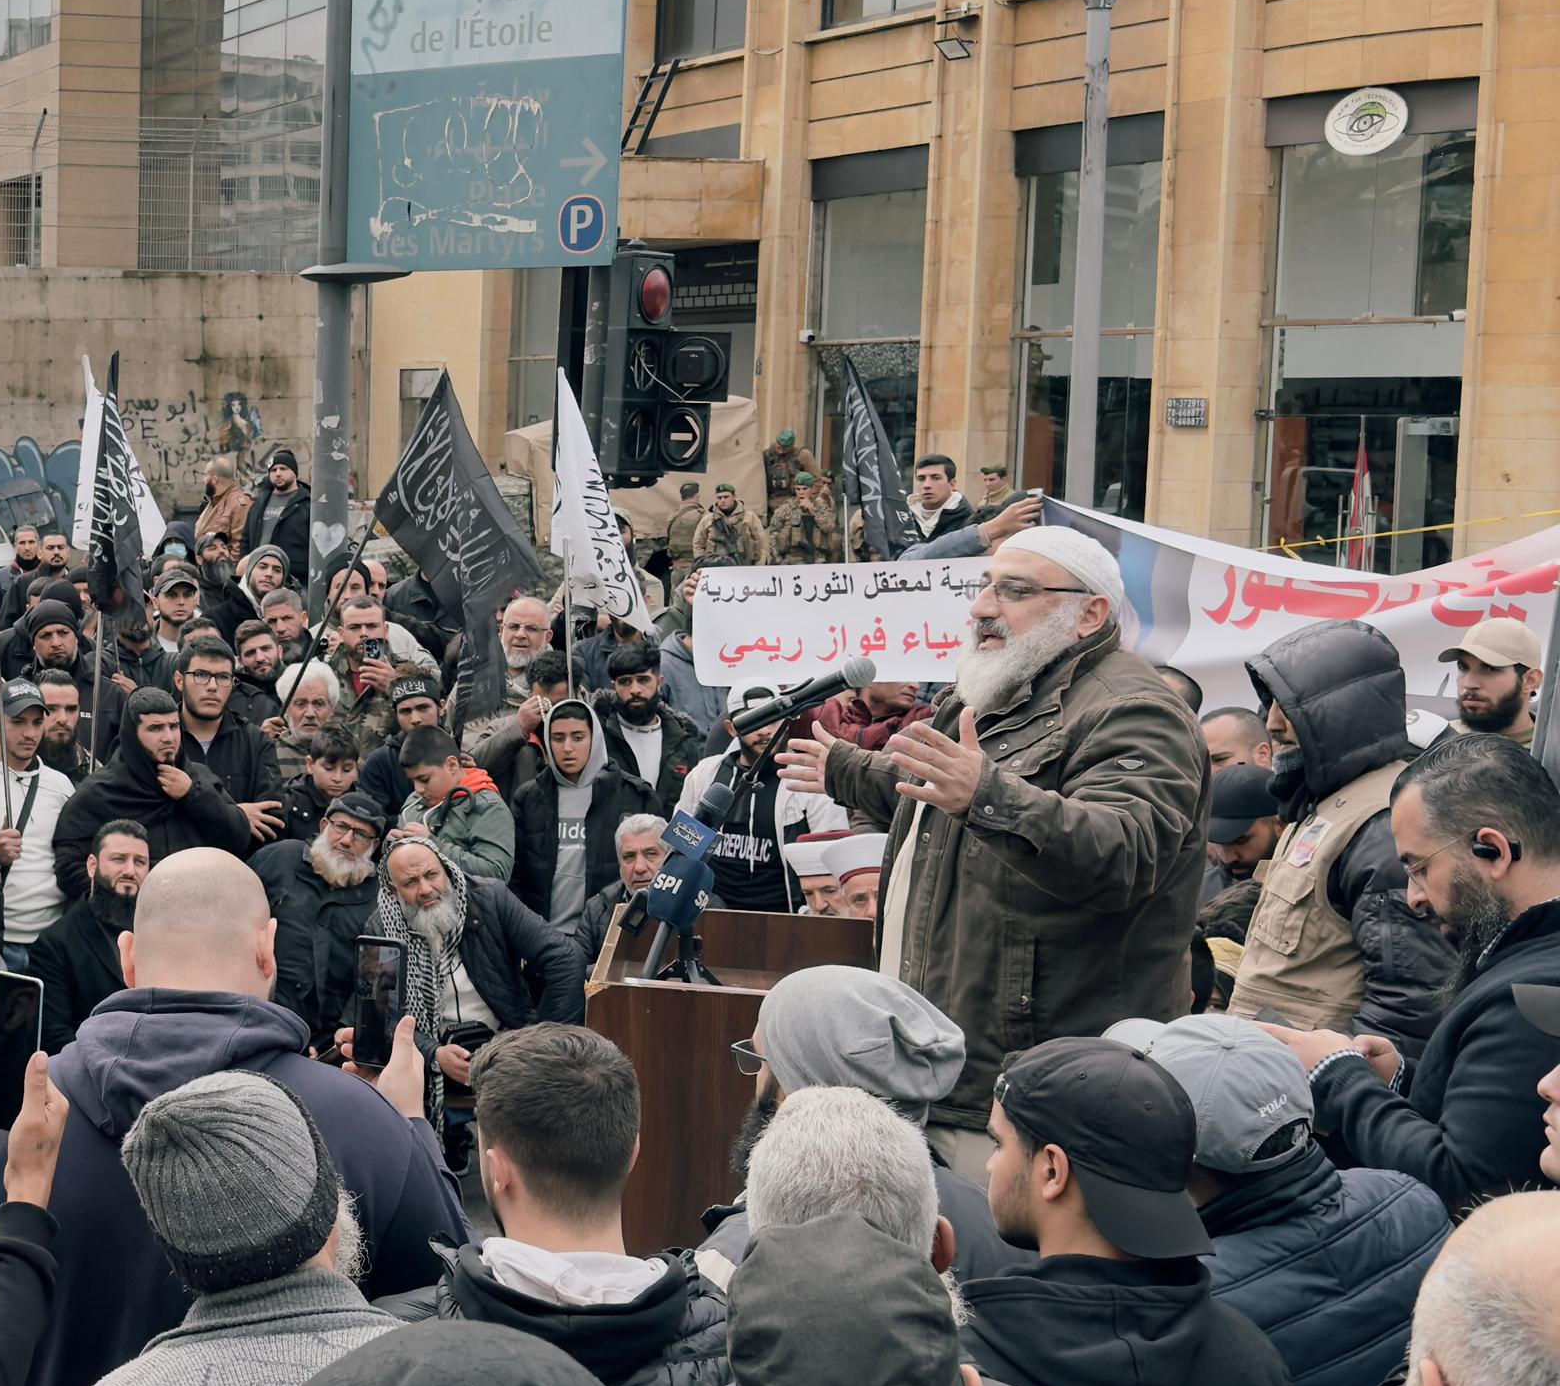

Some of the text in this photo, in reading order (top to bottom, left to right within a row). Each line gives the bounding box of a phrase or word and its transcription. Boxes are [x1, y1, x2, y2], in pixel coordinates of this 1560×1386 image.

[409, 10, 553, 54] de l'Étoile
[569, 204, 593, 245] P
[371, 225, 548, 266] des Martyrs
[700, 575, 783, 603] السورية
[793, 571, 854, 602] الثورة
[863, 570, 932, 602] لمعتقل
[718, 633, 803, 668] ريمي
[816, 616, 886, 662] فواز
[653, 873, 683, 895] SPI
[1257, 1093, 1287, 1118] POLO
